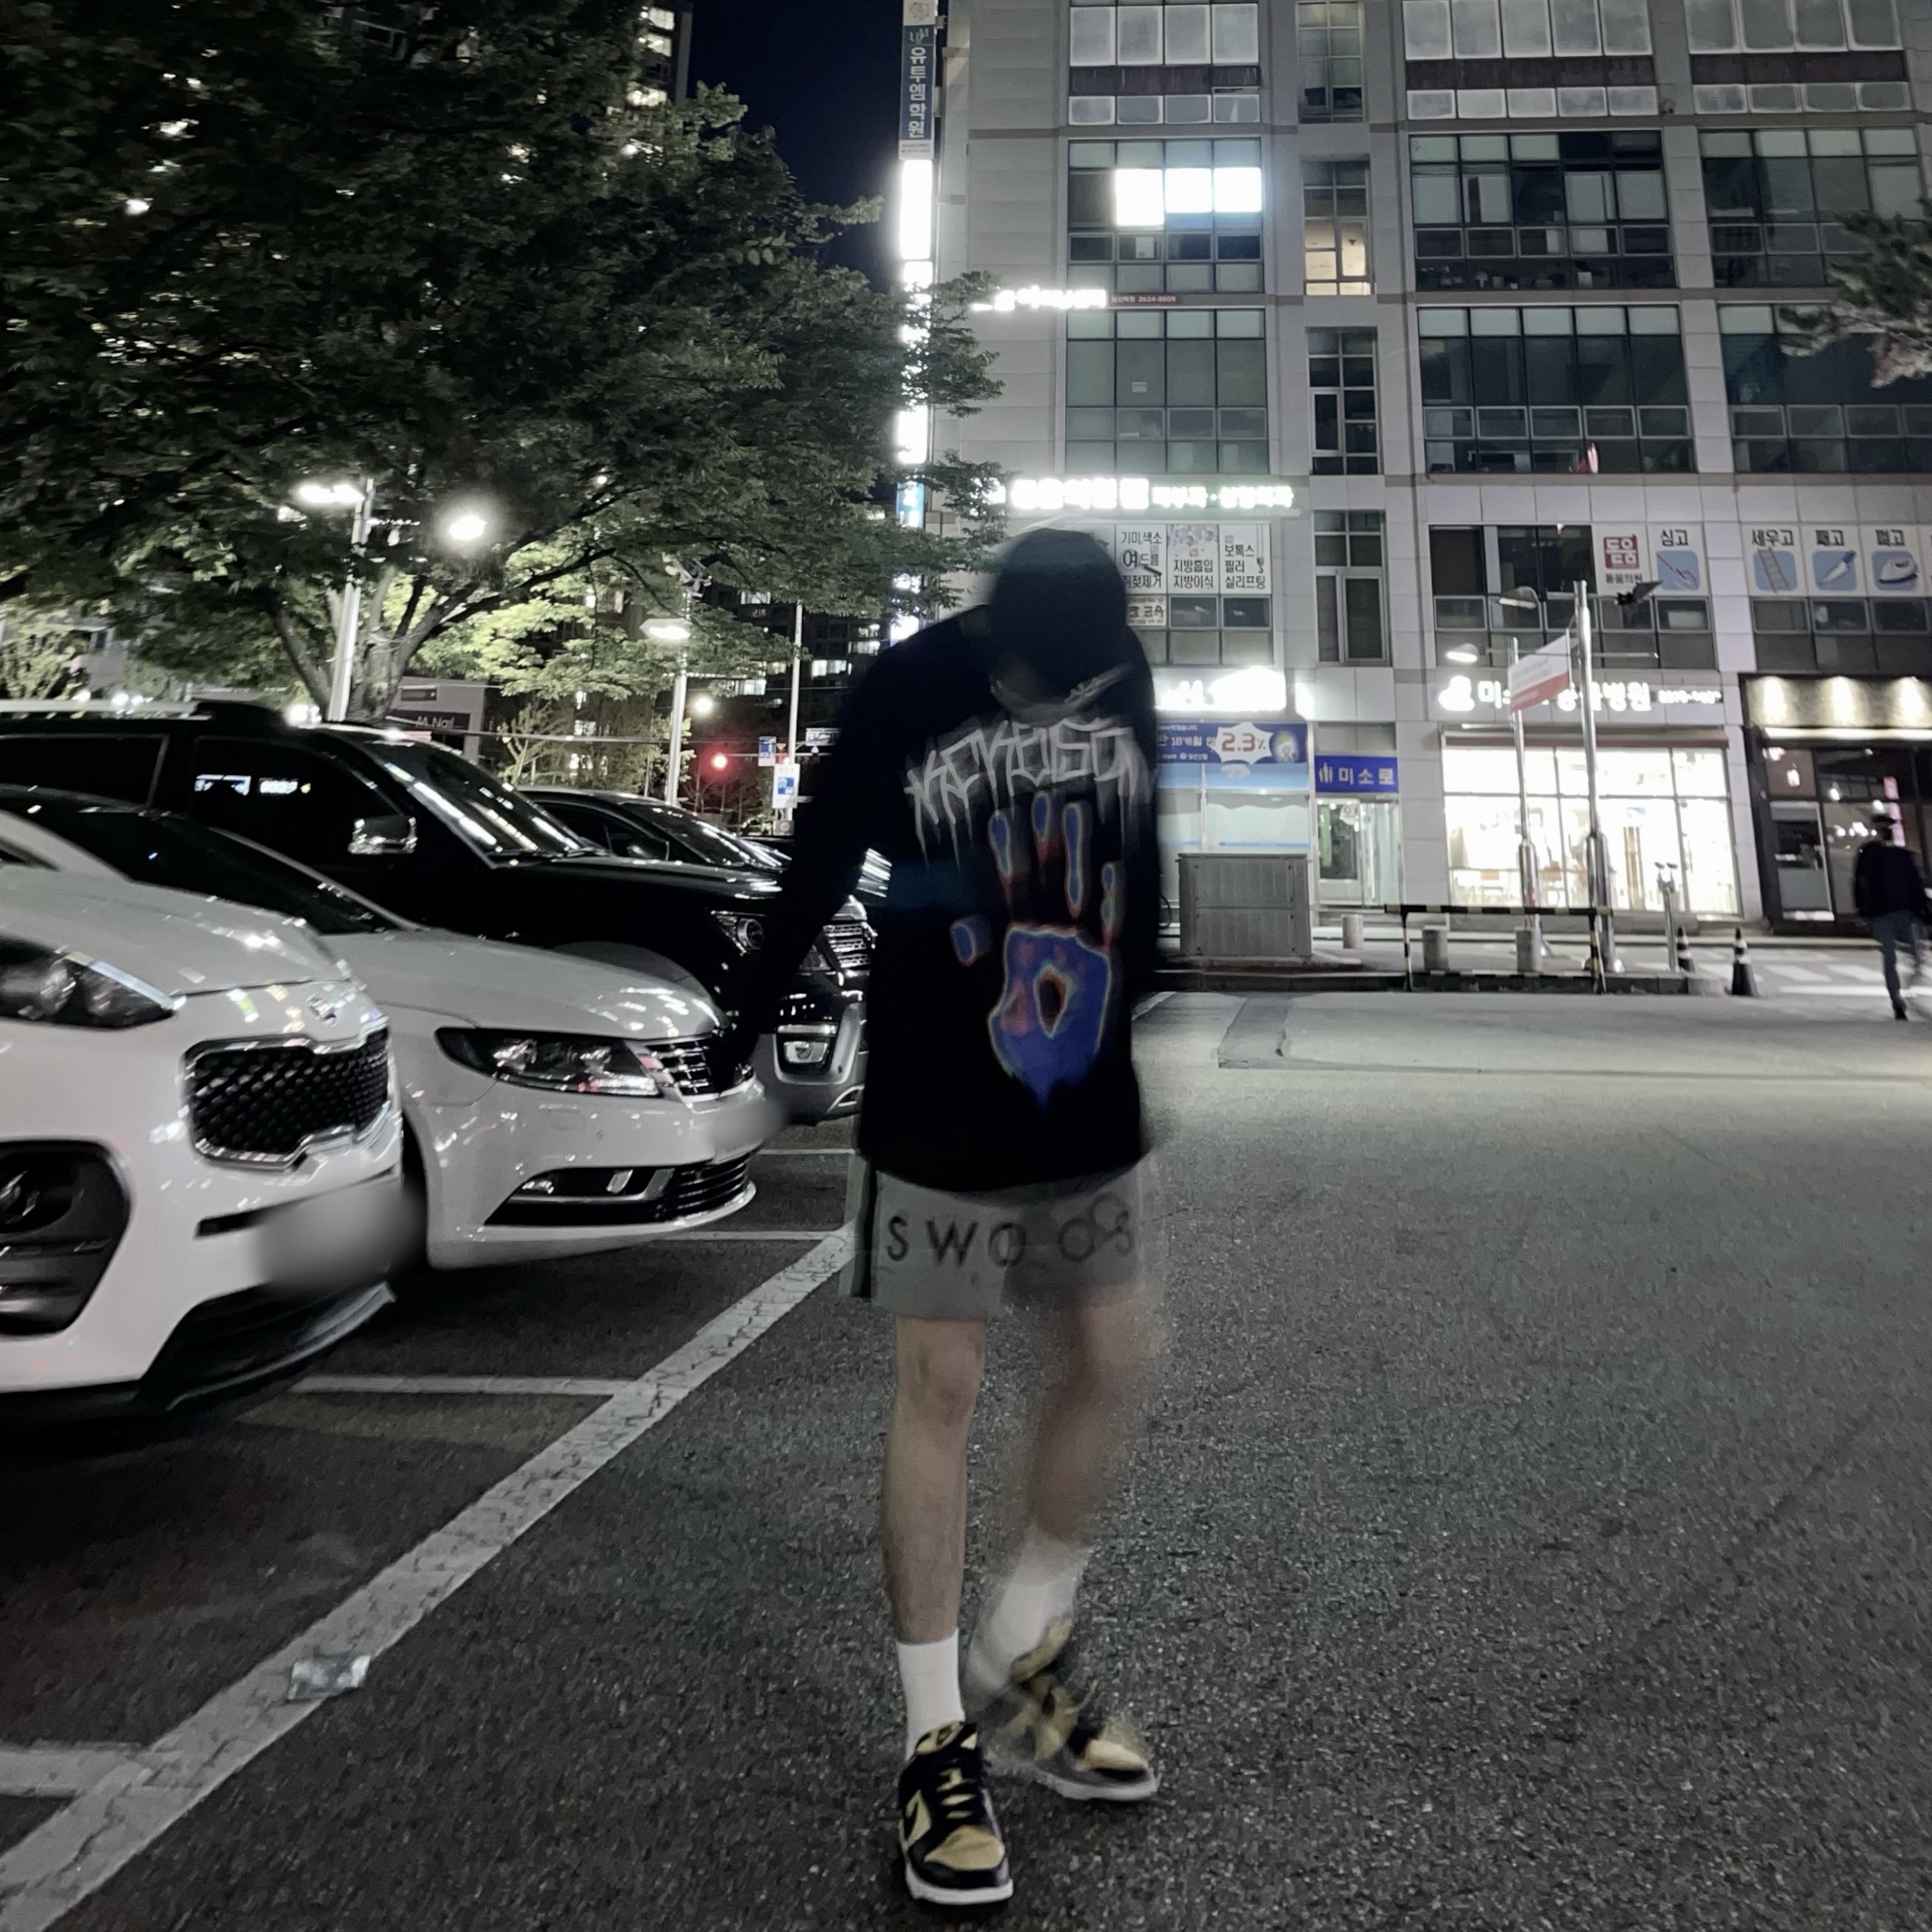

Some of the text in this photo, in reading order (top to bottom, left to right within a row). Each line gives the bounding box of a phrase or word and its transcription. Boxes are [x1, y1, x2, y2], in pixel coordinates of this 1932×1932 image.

[908, 47, 927, 139] 유투엠학원
[1661, 529, 1689, 547] 심고
[1752, 529, 1794, 547] 세우고
[1225, 544, 1254, 557] 보톡스
[1173, 559, 1212, 573] 지방흡입
[1225, 560, 1244, 573] 필러
[1173, 575, 1213, 589] 지방이식
[1225, 575, 1265, 589] 실리프팅
[1339, 767, 1395, 785] 미소로
